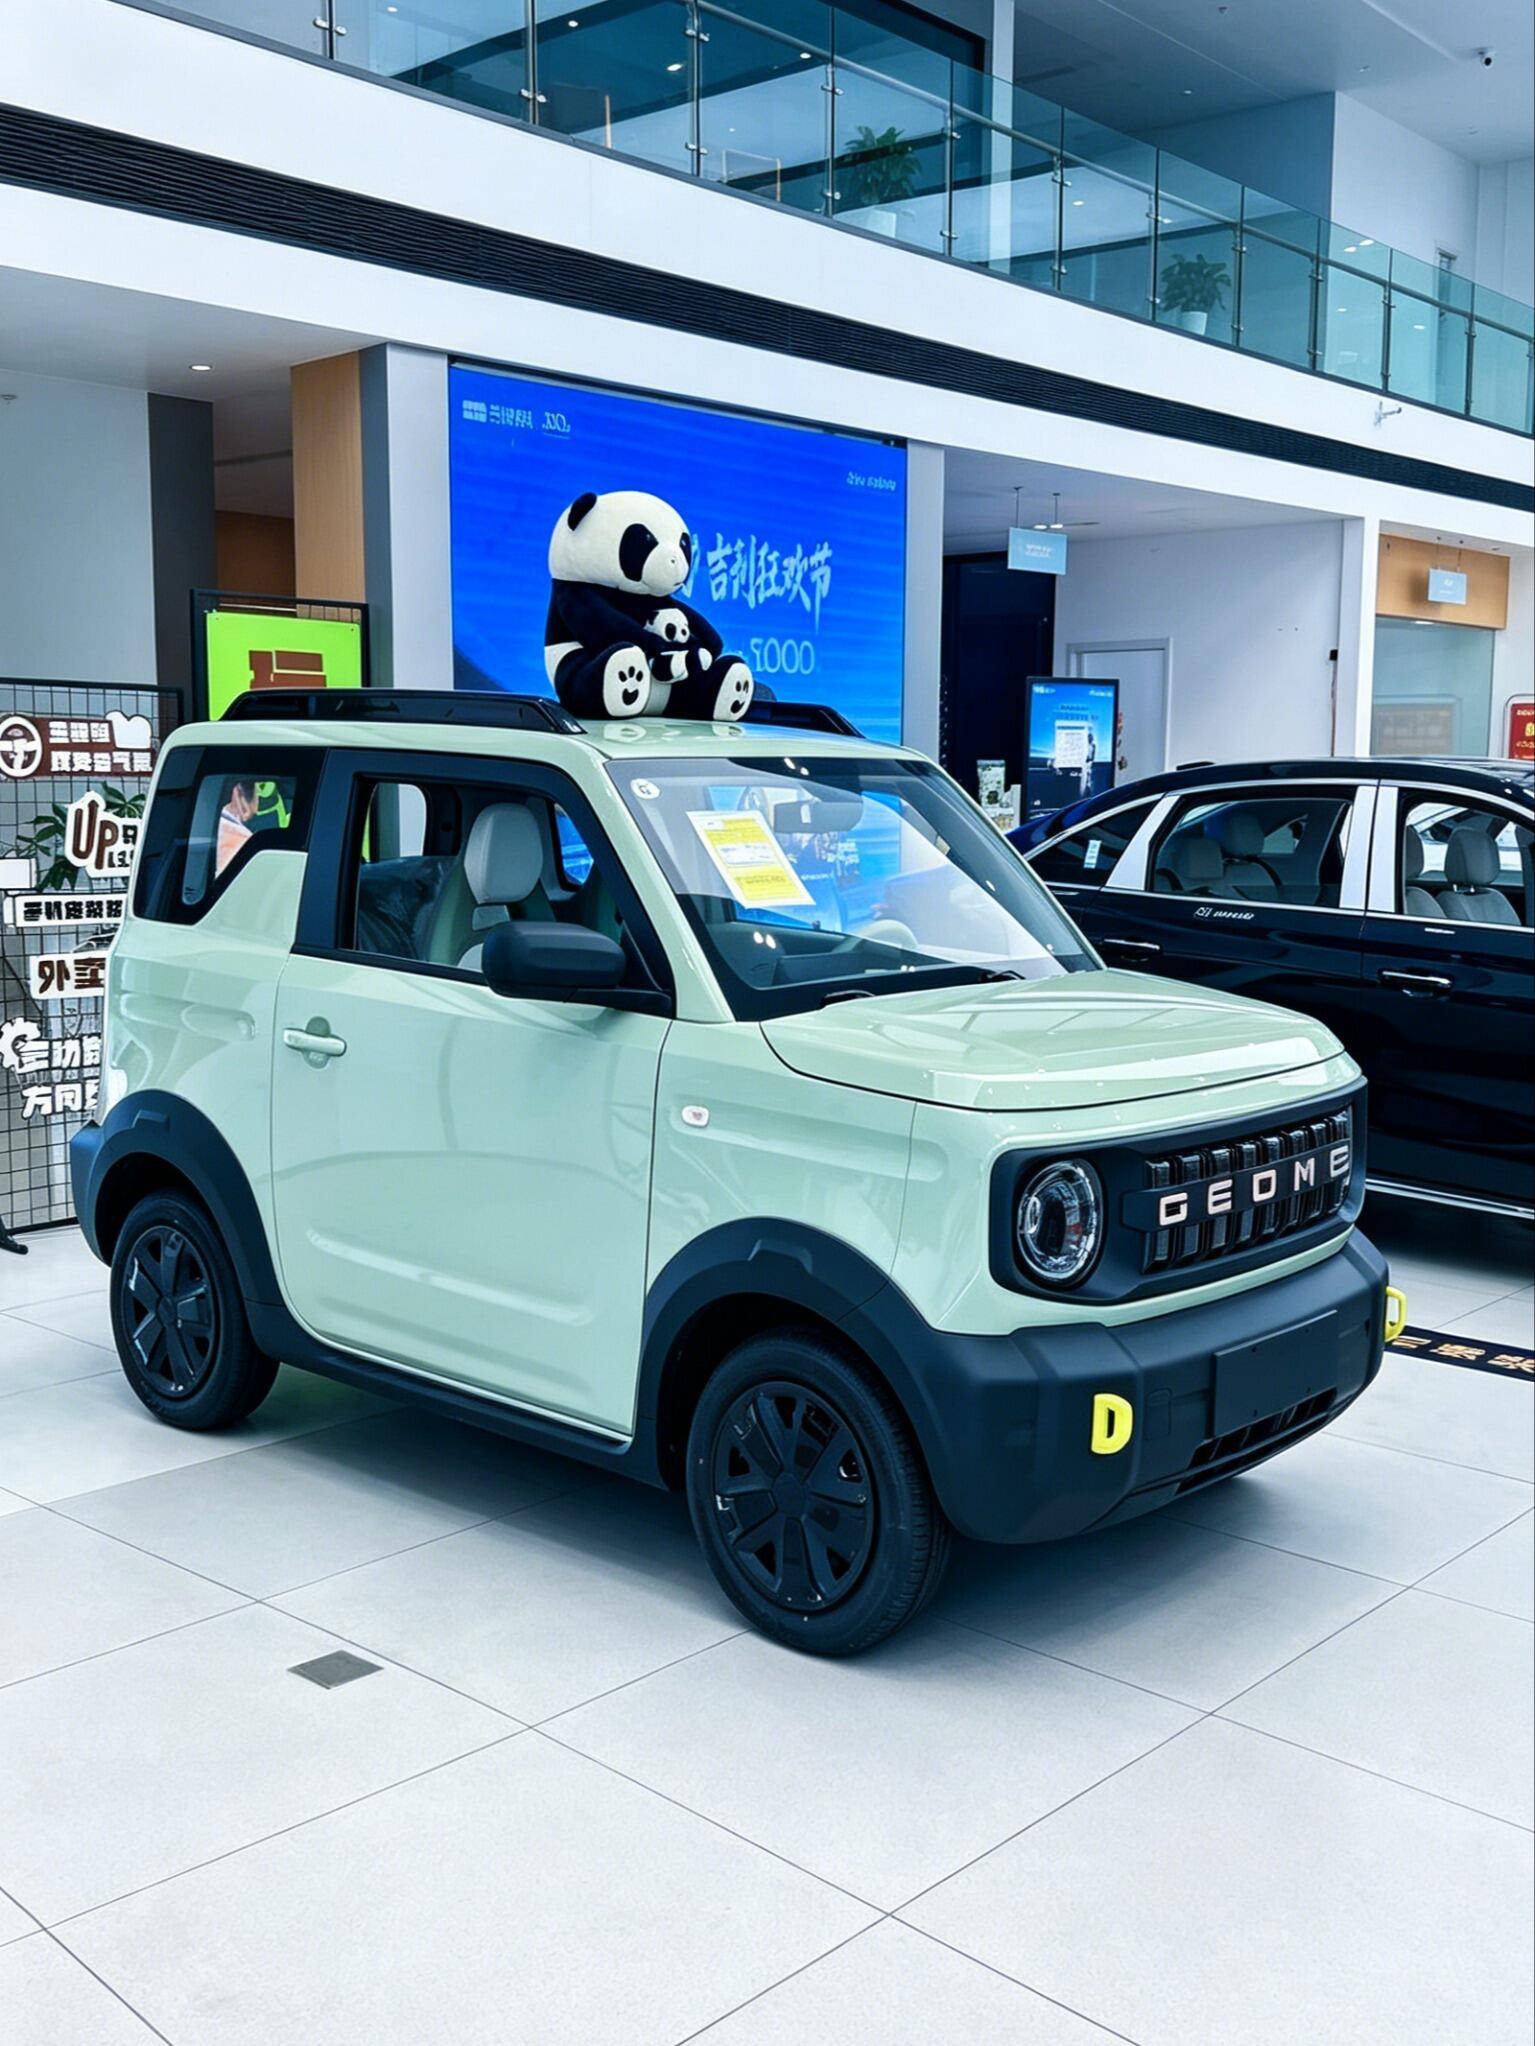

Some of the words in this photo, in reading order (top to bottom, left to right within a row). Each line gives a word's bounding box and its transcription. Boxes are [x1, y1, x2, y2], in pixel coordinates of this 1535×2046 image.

[682, 532, 833, 635] 吉利狂欢节
[1158, 1144, 1350, 1226] GEOME
